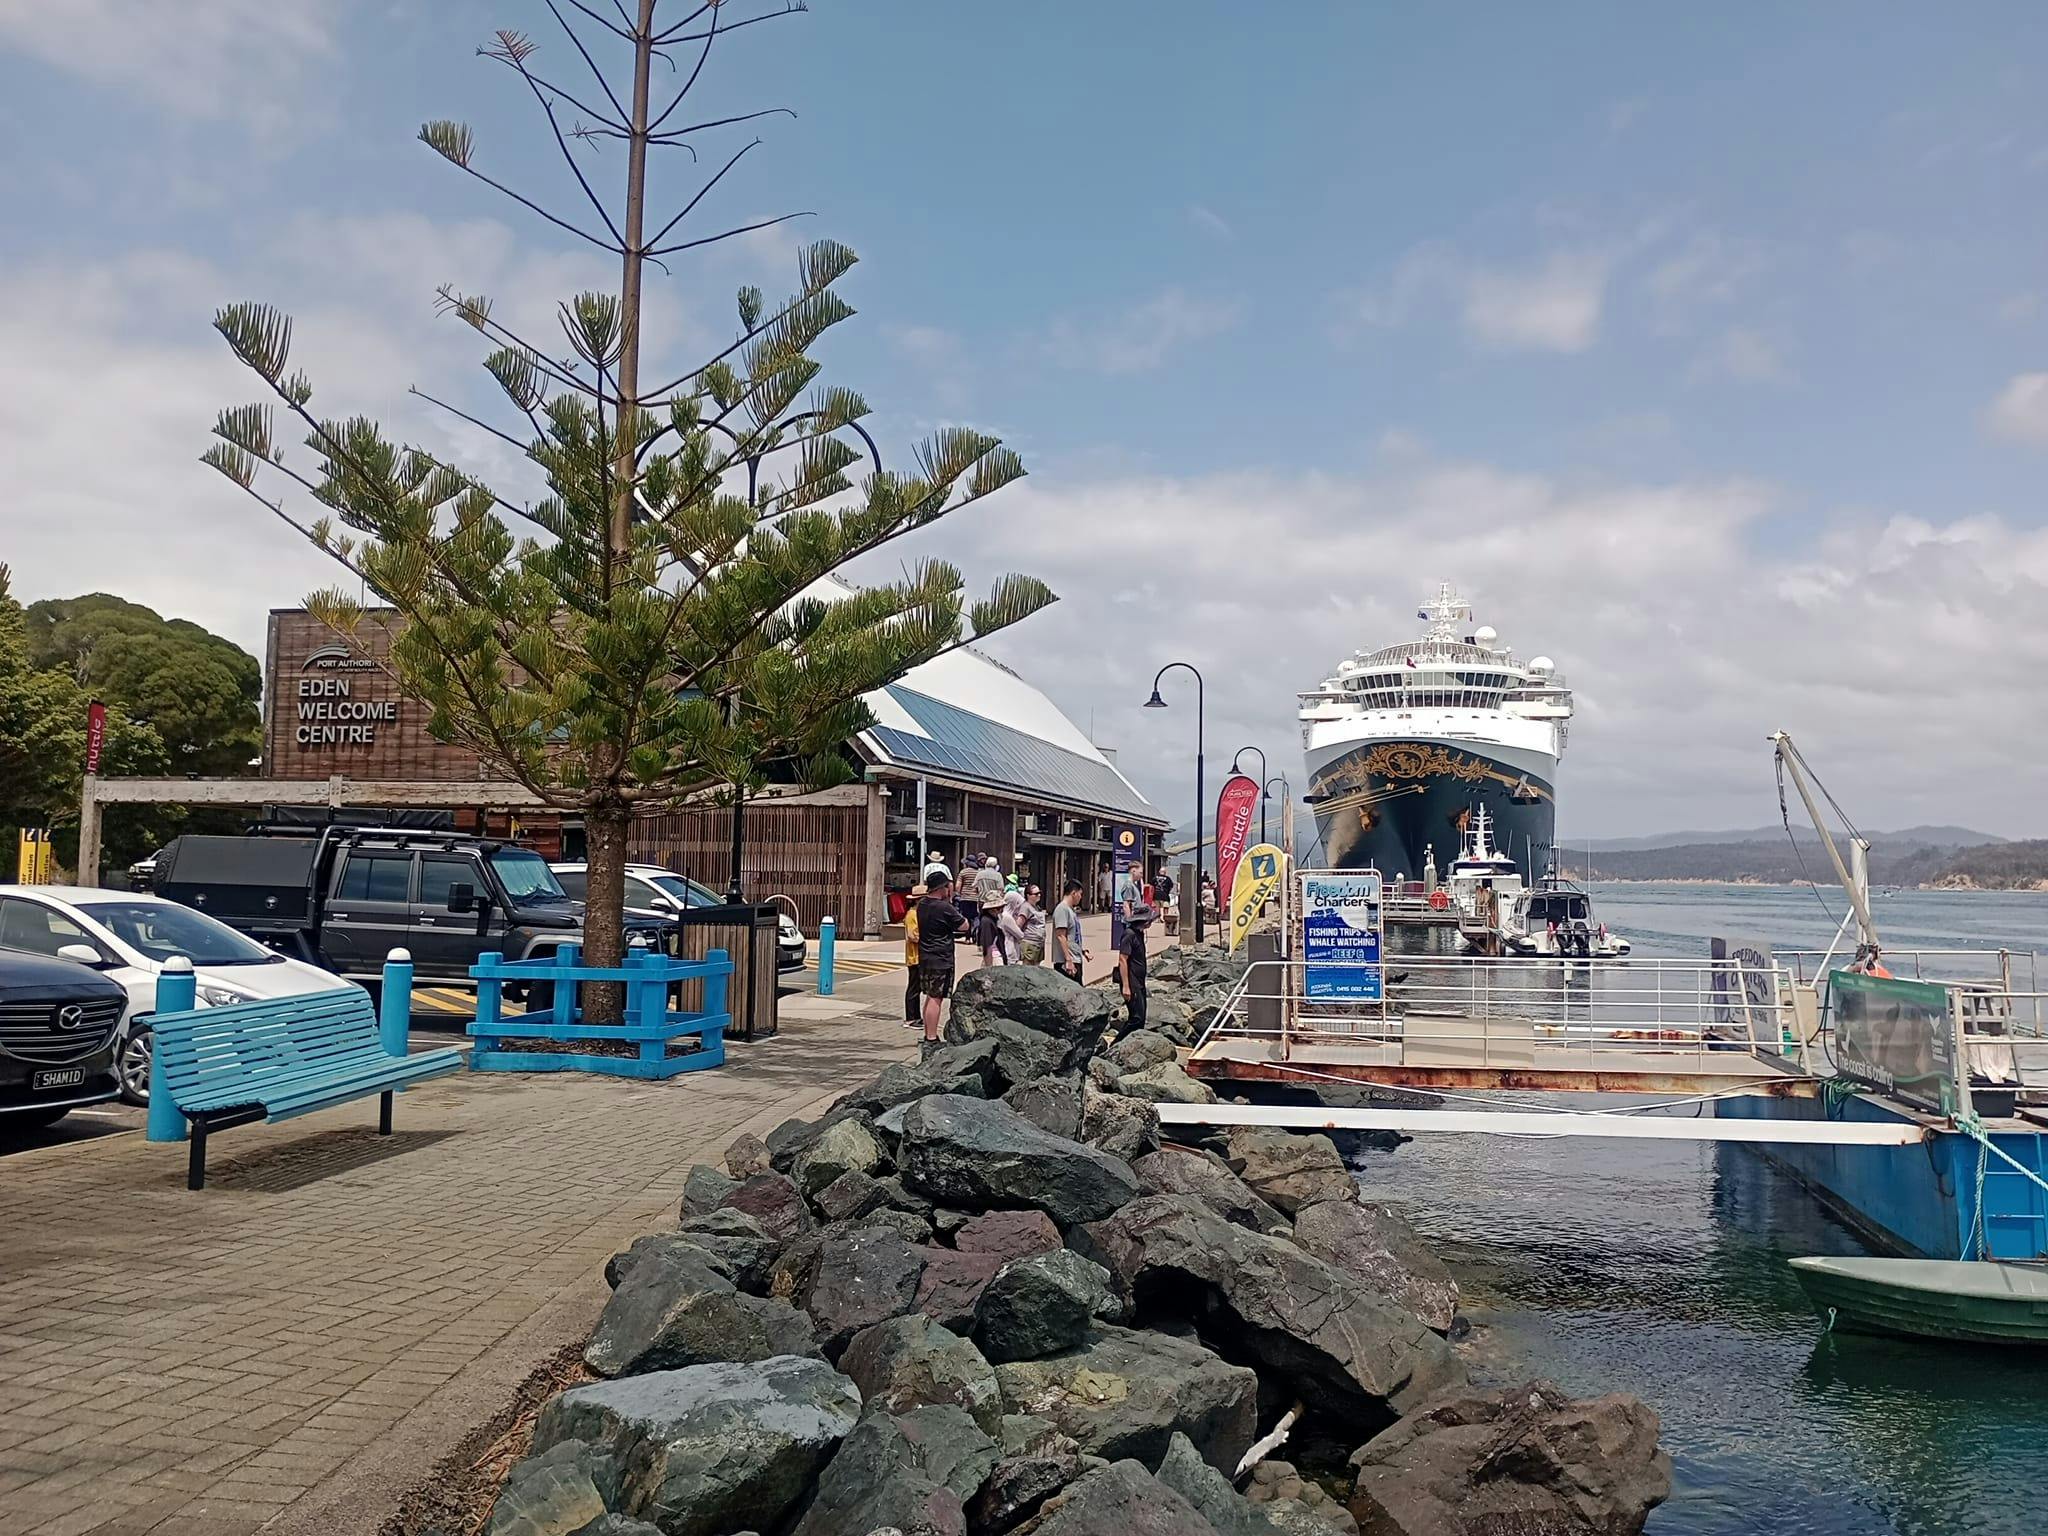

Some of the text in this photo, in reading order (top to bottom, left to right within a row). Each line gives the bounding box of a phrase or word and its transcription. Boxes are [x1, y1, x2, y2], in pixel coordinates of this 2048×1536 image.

[298, 679, 350, 696] EDEN
[297, 702, 396, 720] WELCOME
[296, 725, 374, 743] CENTRE
[87, 718, 102, 775] huttle
[1222, 806, 1249, 861] Shuttle
[1306, 881, 1371, 897] Freedom
[1236, 882, 1270, 927] OPEN
[1314, 896, 1371, 907] Charters
[1308, 927, 1339, 937] FISHING
[1339, 927, 1362, 937] TRIPS
[1308, 938, 1377, 947] WHALE WATCHING
[1331, 948, 1356, 959] REEF
